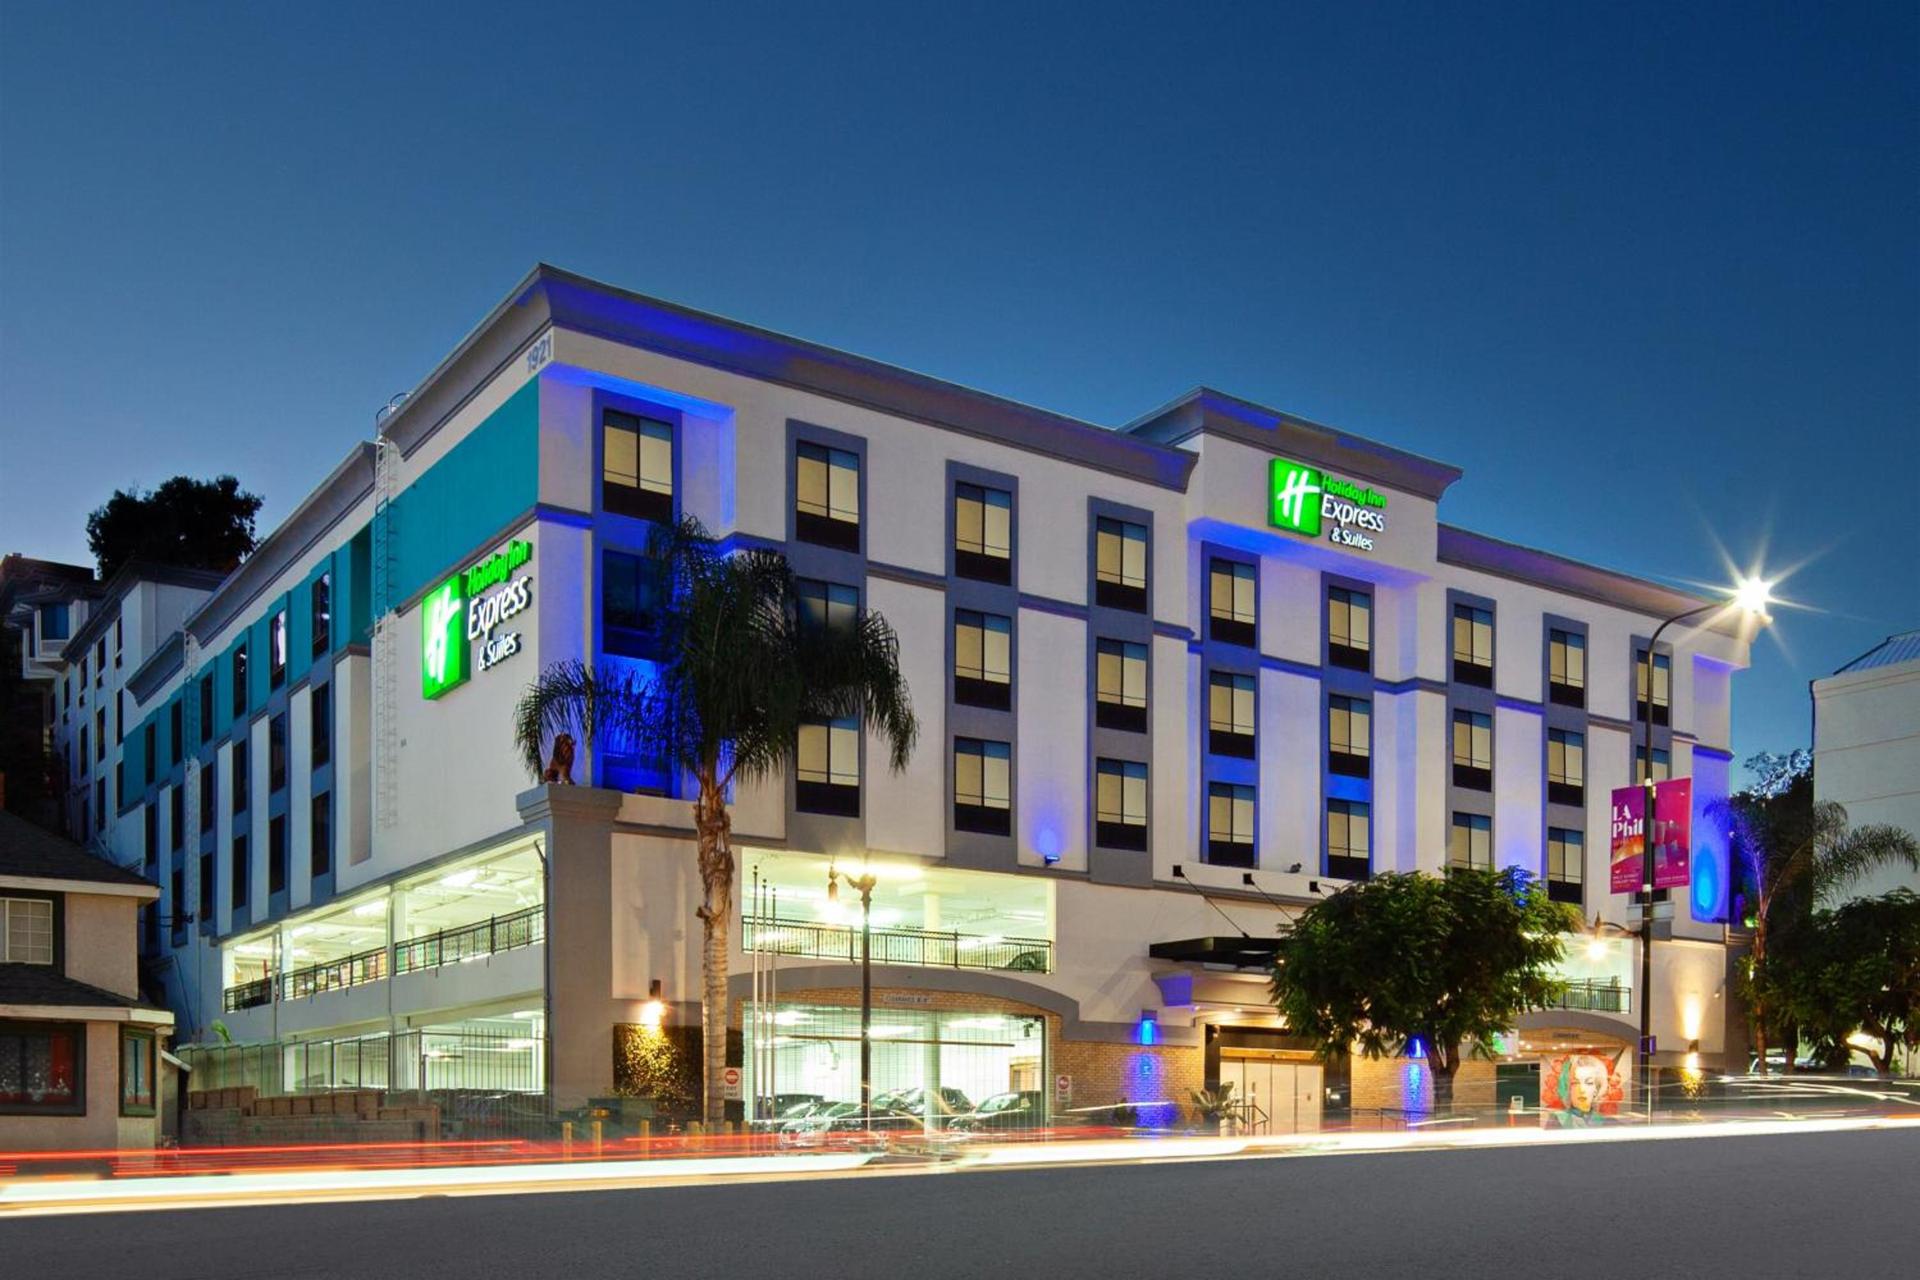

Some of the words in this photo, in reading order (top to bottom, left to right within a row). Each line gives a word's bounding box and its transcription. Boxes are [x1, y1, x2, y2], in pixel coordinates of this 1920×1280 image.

[1322, 474, 1366, 506] Holiday
[1366, 487, 1386, 508] Inn
[1321, 493, 1384, 532] Express
[1331, 527, 1340, 542] &
[1342, 529, 1373, 551] Suites
[467, 552, 510, 597] Holiday
[509, 540, 532, 570] Inn
[467, 575, 529, 641] Express
[478, 646, 486, 671] &
[487, 632, 517, 667] Suites
[1612, 818, 1643, 838] Phil
[1613, 804, 1631, 821] LA
